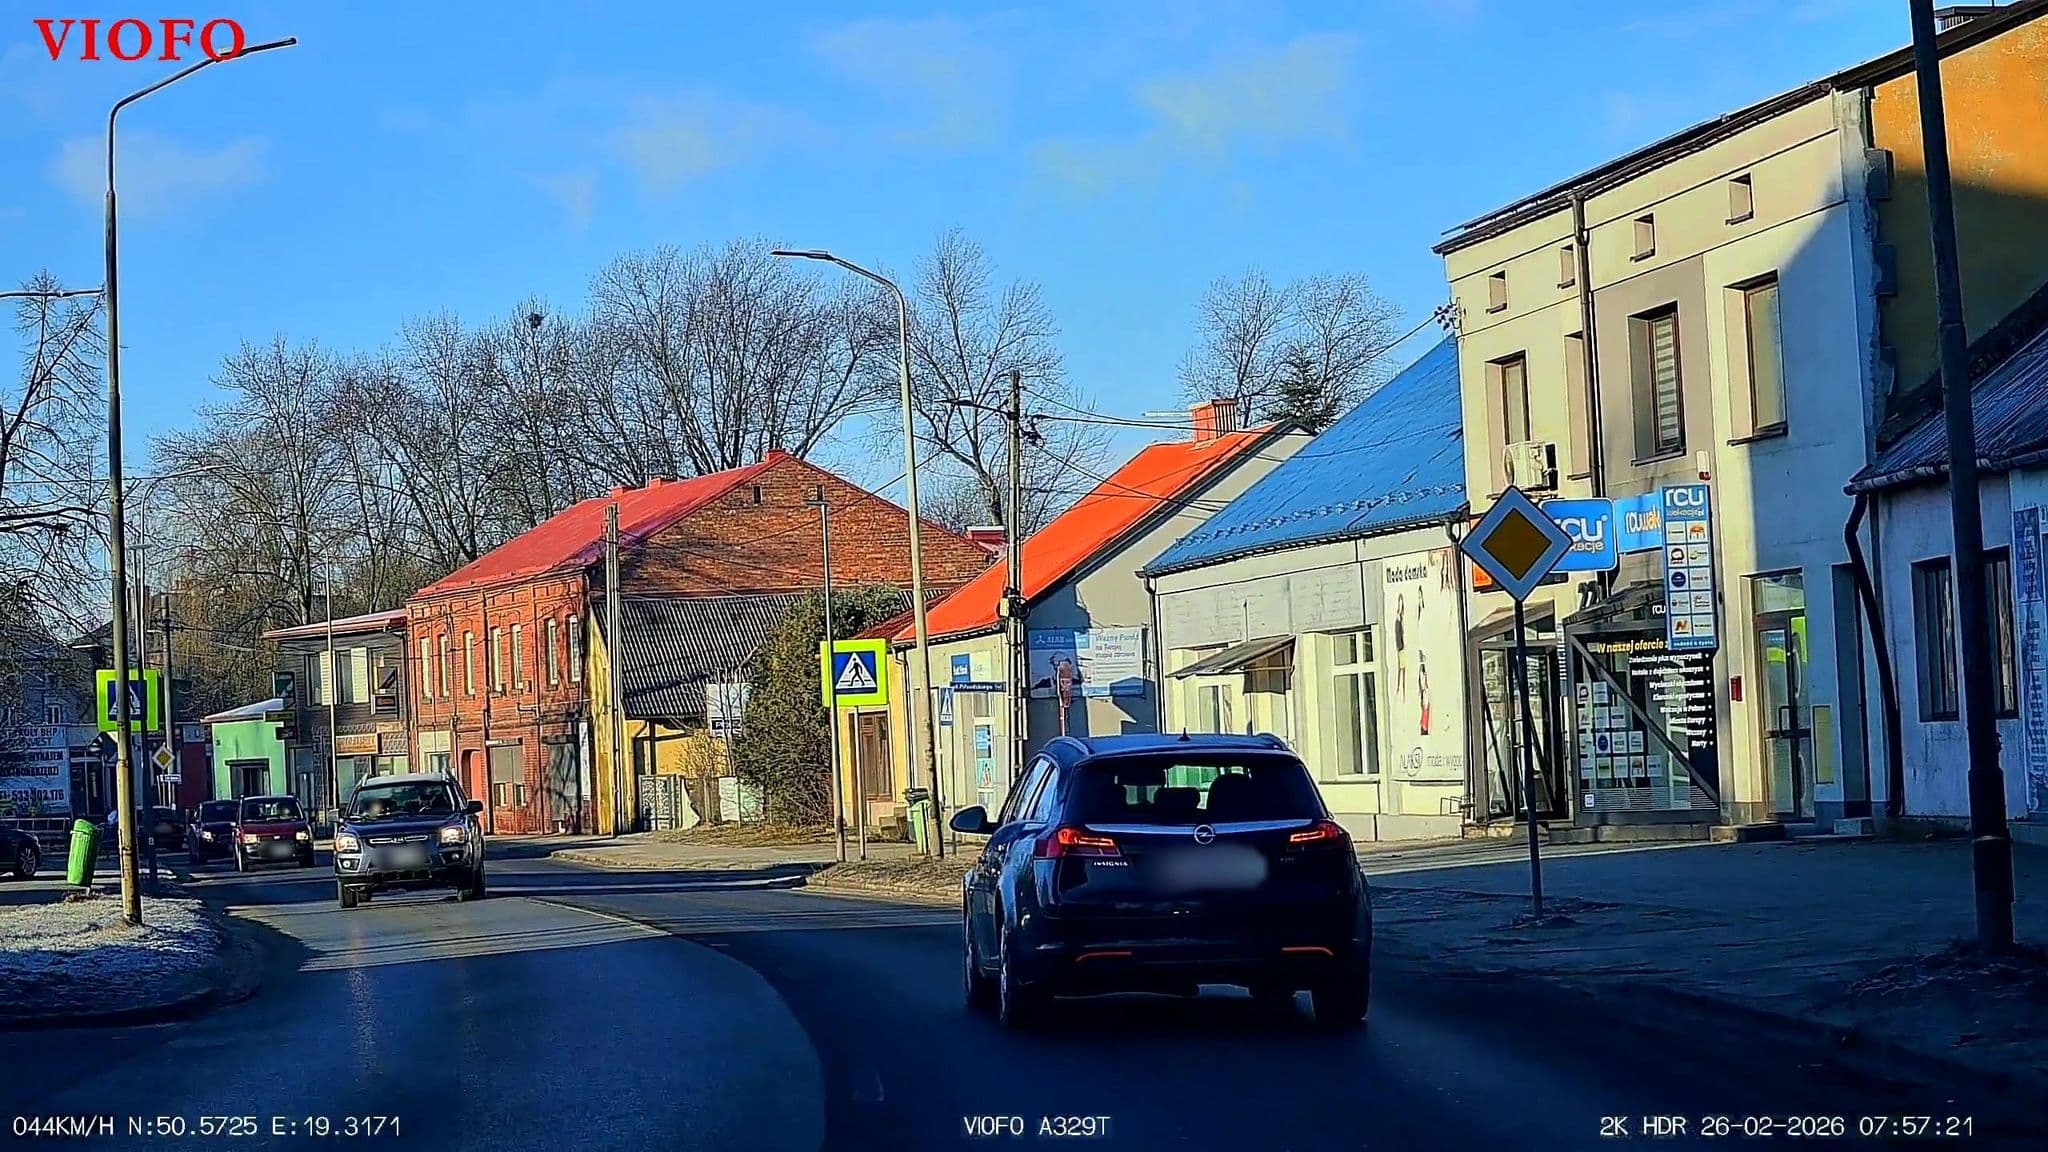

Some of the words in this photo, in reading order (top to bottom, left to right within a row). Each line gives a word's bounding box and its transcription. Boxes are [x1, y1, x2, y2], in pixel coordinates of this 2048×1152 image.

[1666, 487, 1704, 507] rcu
[1569, 541, 1604, 553] kacje
[1386, 566, 1403, 583] Moda
[1606, 640, 1634, 654] naszej
[1634, 638, 1664, 651] ofercie
